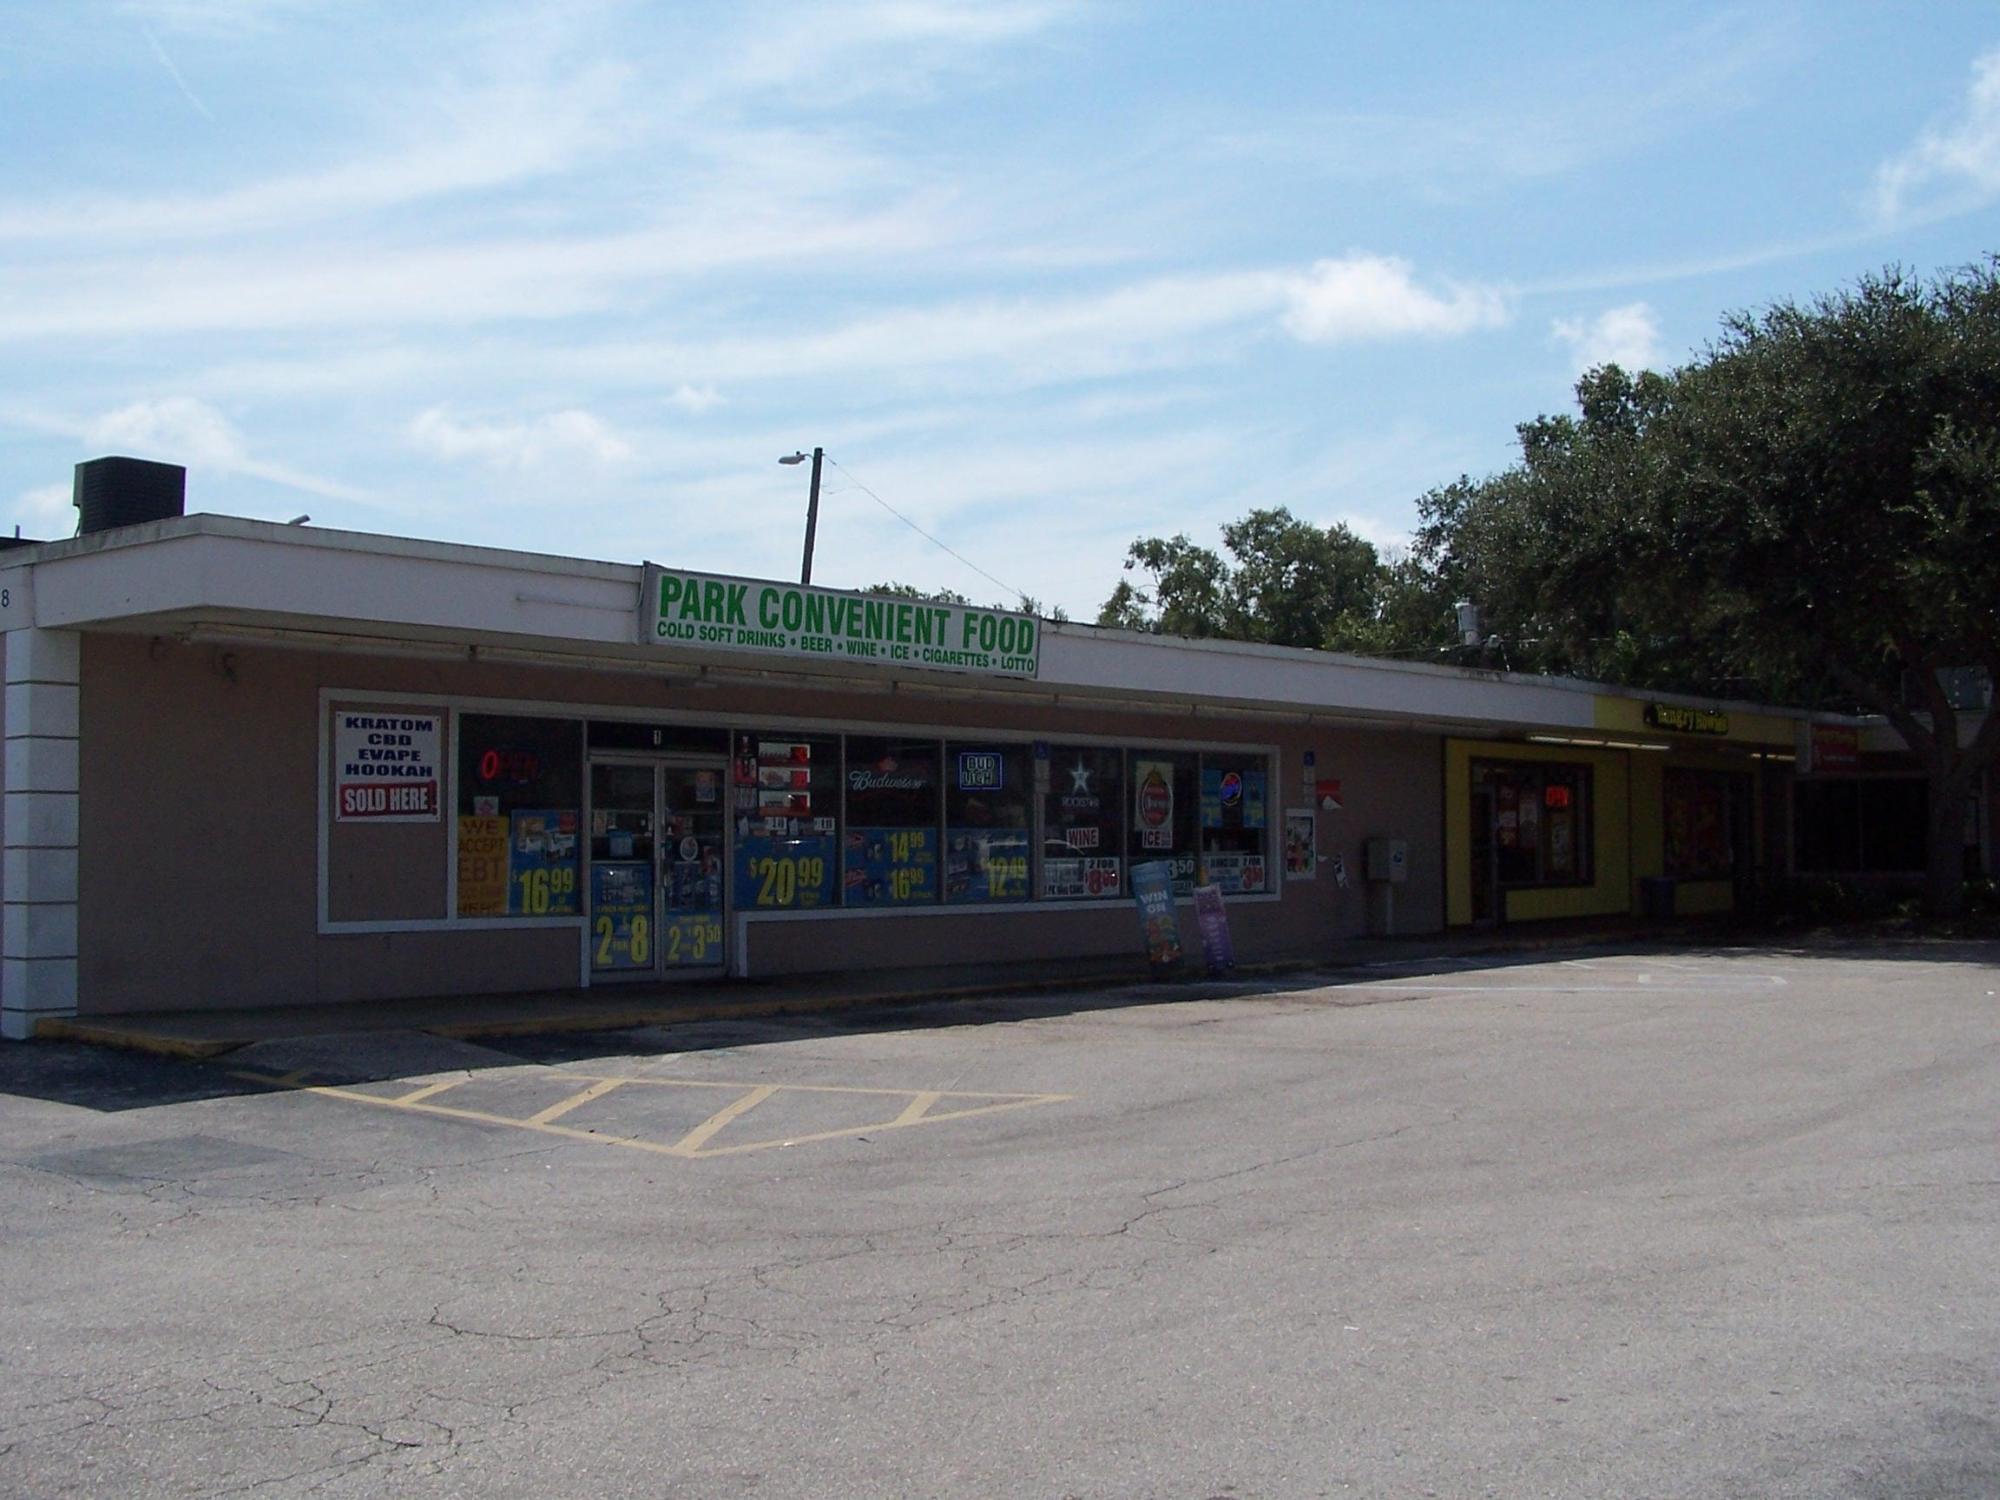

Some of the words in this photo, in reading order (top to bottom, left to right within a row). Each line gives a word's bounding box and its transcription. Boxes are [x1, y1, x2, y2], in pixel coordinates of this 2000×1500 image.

[1, 588, 10, 608] 8
[659, 575, 748, 626] PARK
[758, 587, 951, 647] CONVENIENT
[962, 612, 1035, 656] FOOD
[657, 621, 695, 639] COLD
[699, 626, 734, 644] SOFT
[736, 629, 786, 649] DRINKS
[801, 636, 833, 654] BEER
[846, 640, 877, 657] WINE
[890, 645, 910, 660] ICE
[922, 647, 989, 668] CIGARETTES
[1000, 655, 1034, 673] LOTTO
[345, 717, 433, 732] KRATOM
[367, 733, 412, 746] CBD
[358, 748, 421, 762] EVAPE
[966, 755, 995, 771] BUD
[345, 764, 433, 777] HOOKAH
[344, 787, 384, 813] SOLD
[1068, 829, 1097, 847] WINE
[1144, 831, 1161, 847] ICE
[1139, 889, 1168, 905] WIN
